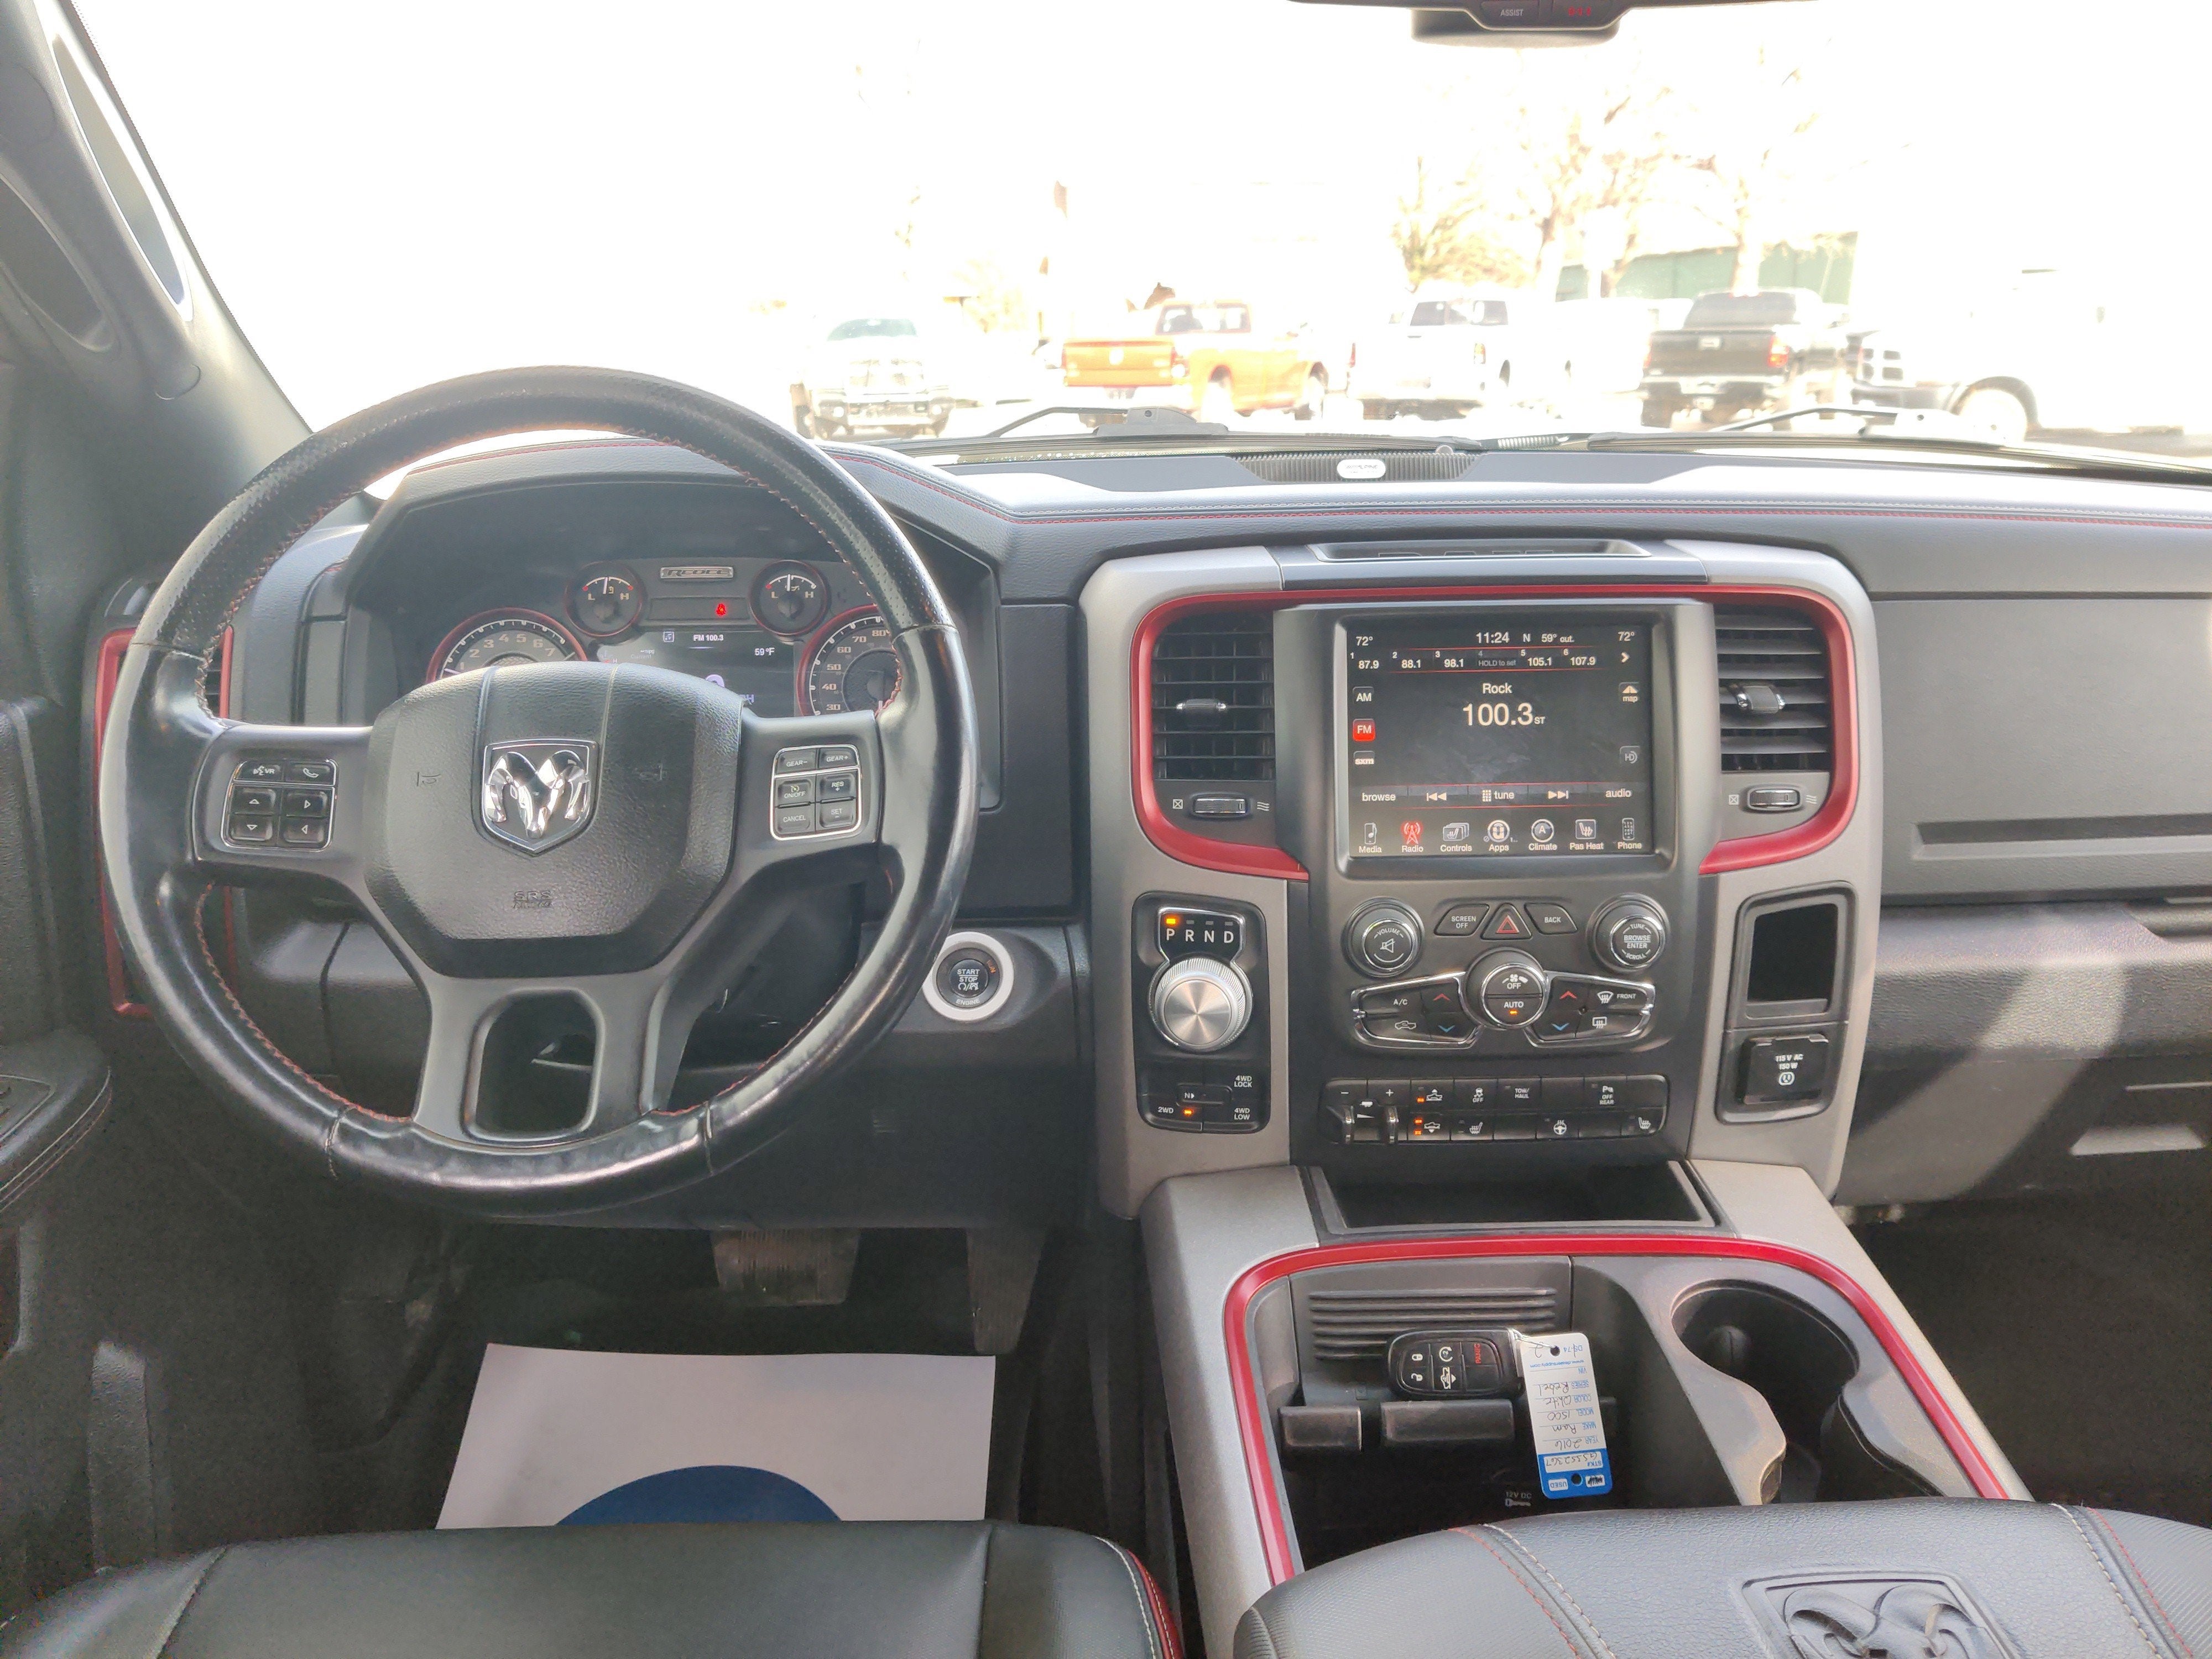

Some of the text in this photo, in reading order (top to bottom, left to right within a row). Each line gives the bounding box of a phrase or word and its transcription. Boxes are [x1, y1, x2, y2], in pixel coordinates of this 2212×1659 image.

[499, 634, 509, 643] 4
[517, 634, 527, 643] 5
[1356, 636, 1373, 646] 72°
[1476, 632, 1510, 644] 11:24
[1522, 633, 1531, 643] N
[1541, 633, 1557, 643] 59°
[1618, 631, 1635, 641] 72°
[483, 639, 495, 649] 3
[533, 639, 544, 648] 6
[469, 649, 480, 658] 2
[545, 648, 556, 657] 7
[1350, 651, 1355, 660] 1
[1391, 651, 1398, 659] 2
[1358, 660, 1380, 670] 87.9
[1401, 659, 1422, 669] 88.1
[1443, 659, 1464, 667] 98.1
[1527, 656, 1552, 666] 105.1
[1569, 656, 1597, 666] 107.9
[1483, 682, 1513, 695] Rock
[1356, 692, 1372, 702] AM
[1623, 695, 1639, 704] map
[1463, 702, 1546, 727] 100.3 ST
[1357, 725, 1372, 734] FM
[1362, 792, 1396, 802] browse
[1494, 791, 1515, 800] tune
[1605, 789, 1632, 798] audio
[1440, 844, 1473, 852] Controls
[1489, 844, 1509, 853] Apps
[1528, 843, 1558, 851] Climate
[1569, 842, 1604, 851] Pas Heat
[514, 890, 553, 901] SRS
[1166, 928, 1234, 943] P R N D
[1377, 927, 1401, 936] VOLUME
[1625, 952, 1647, 961] SCROLL
[956, 998, 981, 1006] ENGINE
[1538, 1381, 1569, 1396] Rebel
[1572, 1380, 1590, 1390] SERIES
[1574, 1394, 1592, 1404] COLOR
[1547, 1411, 1570, 1421] 1500
[1577, 1407, 1595, 1417] MODEL
[1551, 1423, 1577, 1434] Ram
[1582, 1421, 1597, 1431] MAKE
[1554, 1439, 1583, 1451] 2016
[1585, 1436, 1599, 1444] YEAR
